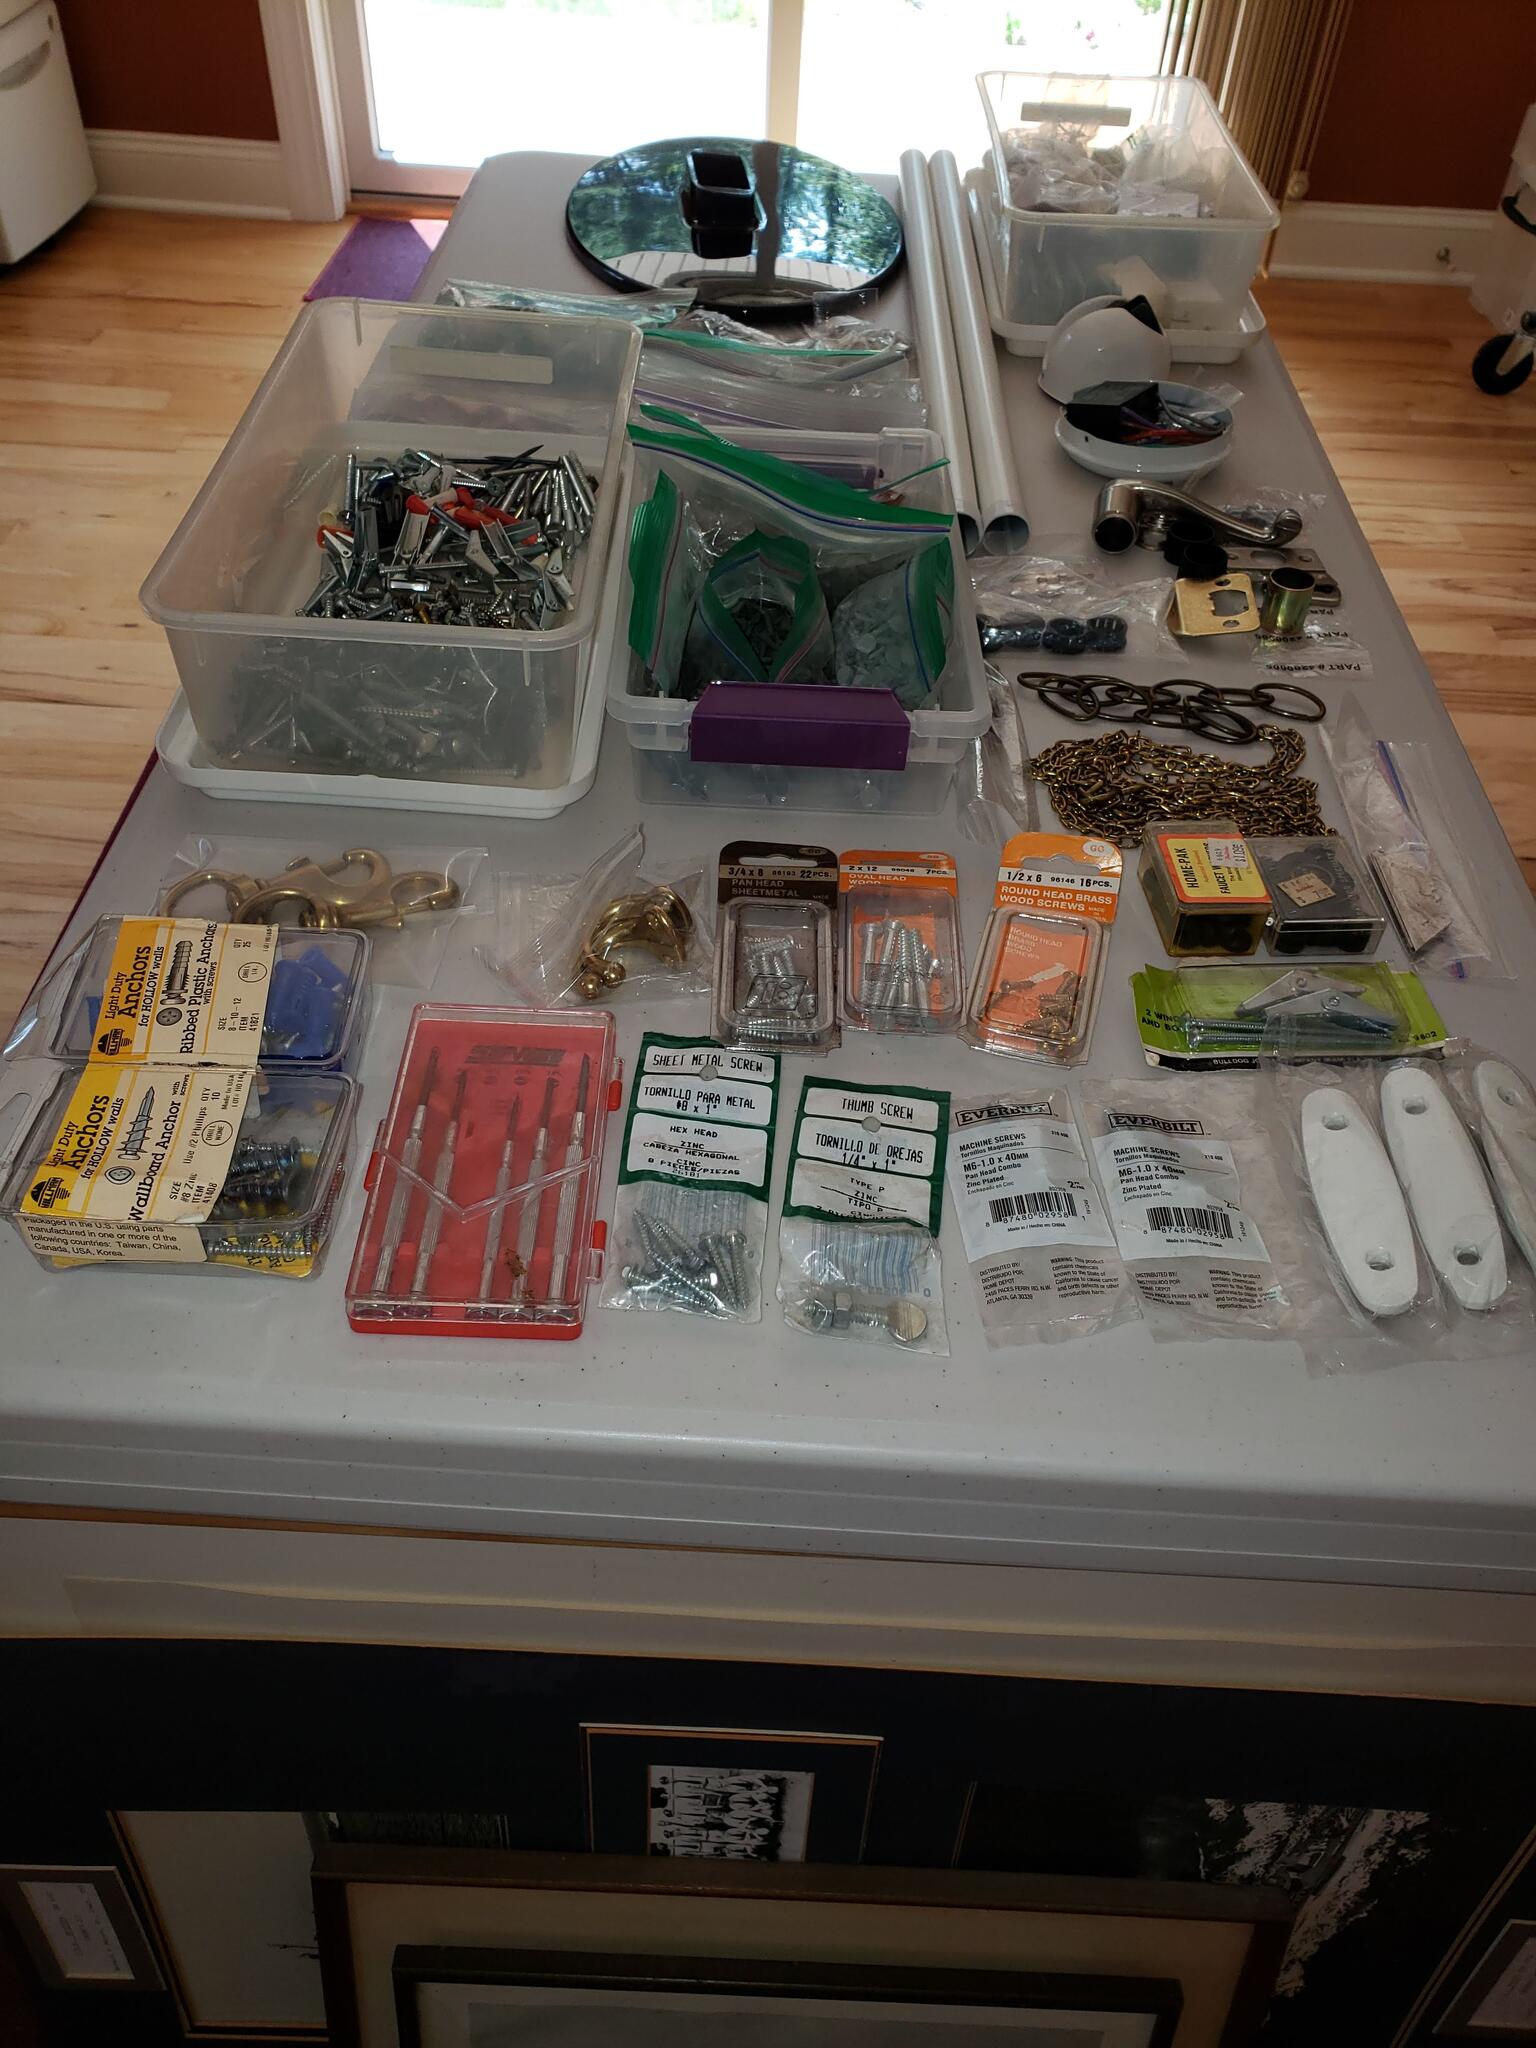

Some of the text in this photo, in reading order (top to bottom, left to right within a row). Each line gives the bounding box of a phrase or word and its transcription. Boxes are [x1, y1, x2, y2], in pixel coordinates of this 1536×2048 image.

[729, 867, 747, 876] 3/4
[1174, 848, 1199, 888] HOME-PAK
[1007, 872, 1024, 881] 1/2
[1214, 872, 1231, 894] FAUCET
[731, 888, 800, 896] SHEETMETAL
[1001, 886, 1112, 904] ROUND HEAD BRASS
[999, 895, 1085, 911] WOOD SCREWS
[118, 946, 151, 1018] Anchors
[138, 946, 164, 1027] for HOLLOW walls
[188, 967, 208, 1005] Plastic
[202, 961, 217, 1004] with screws
[105, 972, 128, 1019] Light Duty
[1145, 1008, 1151, 1016] 2
[218, 1017, 227, 1030] SIZE
[239, 1017, 248, 1031] ITEM
[1141, 1017, 1161, 1028] AND
[180, 1009, 200, 1053] Ribbed
[653, 1054, 763, 1073] SHEET METAL SCREW
[171, 1081, 181, 1095] with
[180, 1074, 190, 1096] screws
[211, 1092, 221, 1101] 10
[644, 1087, 755, 1110] TORNILLO PARA METAL
[191, 1106, 207, 1137] Phillips
[202, 1087, 210, 1102] QTY
[842, 1098, 913, 1120] THUMB SCREW
[670, 1126, 718, 1138] HEX HEAD
[1114, 1115, 1198, 1133] EVERBILT
[60, 1095, 110, 1170] Anchors
[80, 1097, 124, 1179] for HOLLOW walls
[46, 1120, 78, 1167] Light Duty
[681, 1141, 705, 1149] ZINC
[816, 1133, 924, 1164] TORNILLO DE OREJAS
[959, 1133, 1026, 1152] MACHINE SCREWS
[960, 1141, 1024, 1159] Tornillos Maquinados
[643, 1142, 740, 1161] CABEZA HEXAGONAL
[1113, 1146, 1149, 1157] MACHINE
[1115, 1155, 1142, 1164] Tornillos
[127, 1100, 181, 1221] Wallboard Anchor
[676, 1159, 701, 1167] CINC
[963, 1156, 995, 1172] M6-1.0
[965, 1163, 1022, 1180] Pan Head Combo
[1118, 1164, 1151, 1178] M6-1.0
[1135, 1174, 1153, 1182] Head
[850, 1177, 872, 1190] TYPE
[966, 1175, 1004, 1188] Zinc Plated
[1122, 1185, 1137, 1194] Zinc
[169, 1181, 182, 1199] SIZE
[191, 1185, 204, 1204] ITEM
[855, 1190, 878, 1203] ZINC
[848, 1197, 871, 1211] TIPO
[1039, 1211, 1069, 1219] 02958
[28, 1225, 86, 1237] manufactured
[116, 1223, 140, 1232] using
[142, 1225, 164, 1233] parts
[31, 1233, 181, 1251] following countries: Taiwan, China,
[34, 1243, 125, 1257] Canada, USA, Korea.
[980, 1264, 1011, 1276] DISTRIBUTED
[983, 1278, 1015, 1290] HOME DEPOT
